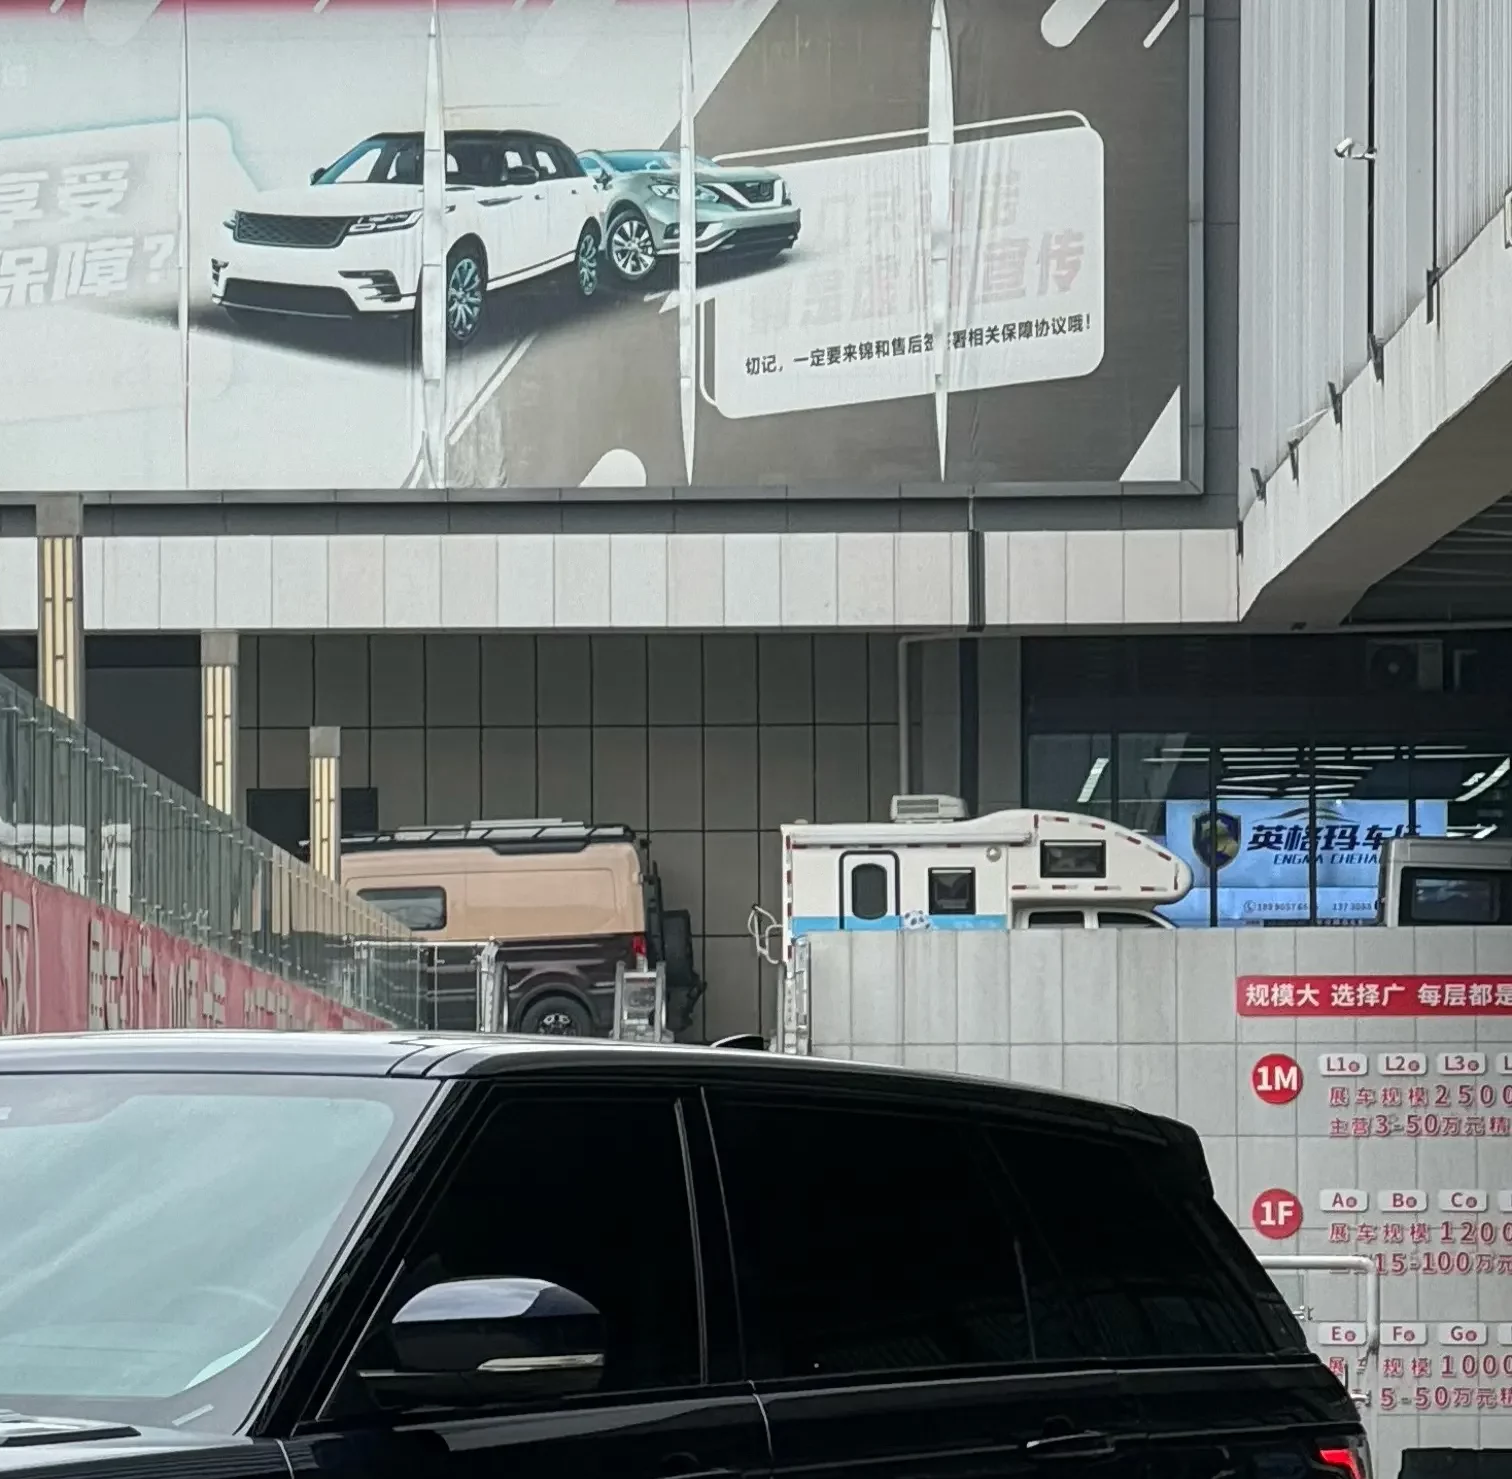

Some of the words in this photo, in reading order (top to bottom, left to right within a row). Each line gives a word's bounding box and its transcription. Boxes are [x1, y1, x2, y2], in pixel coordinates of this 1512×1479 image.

[1330, 853, 1381, 865] CHEHA
[1245, 983, 1320, 1007] 规模大
[1330, 983, 1405, 1007] 选择广
[1417, 983, 1512, 1007] 每层都是
[1256, 1066, 1299, 1092] 1M
[1259, 1201, 1295, 1226] 1F
[1330, 1250, 1512, 1276] 15-100万元
